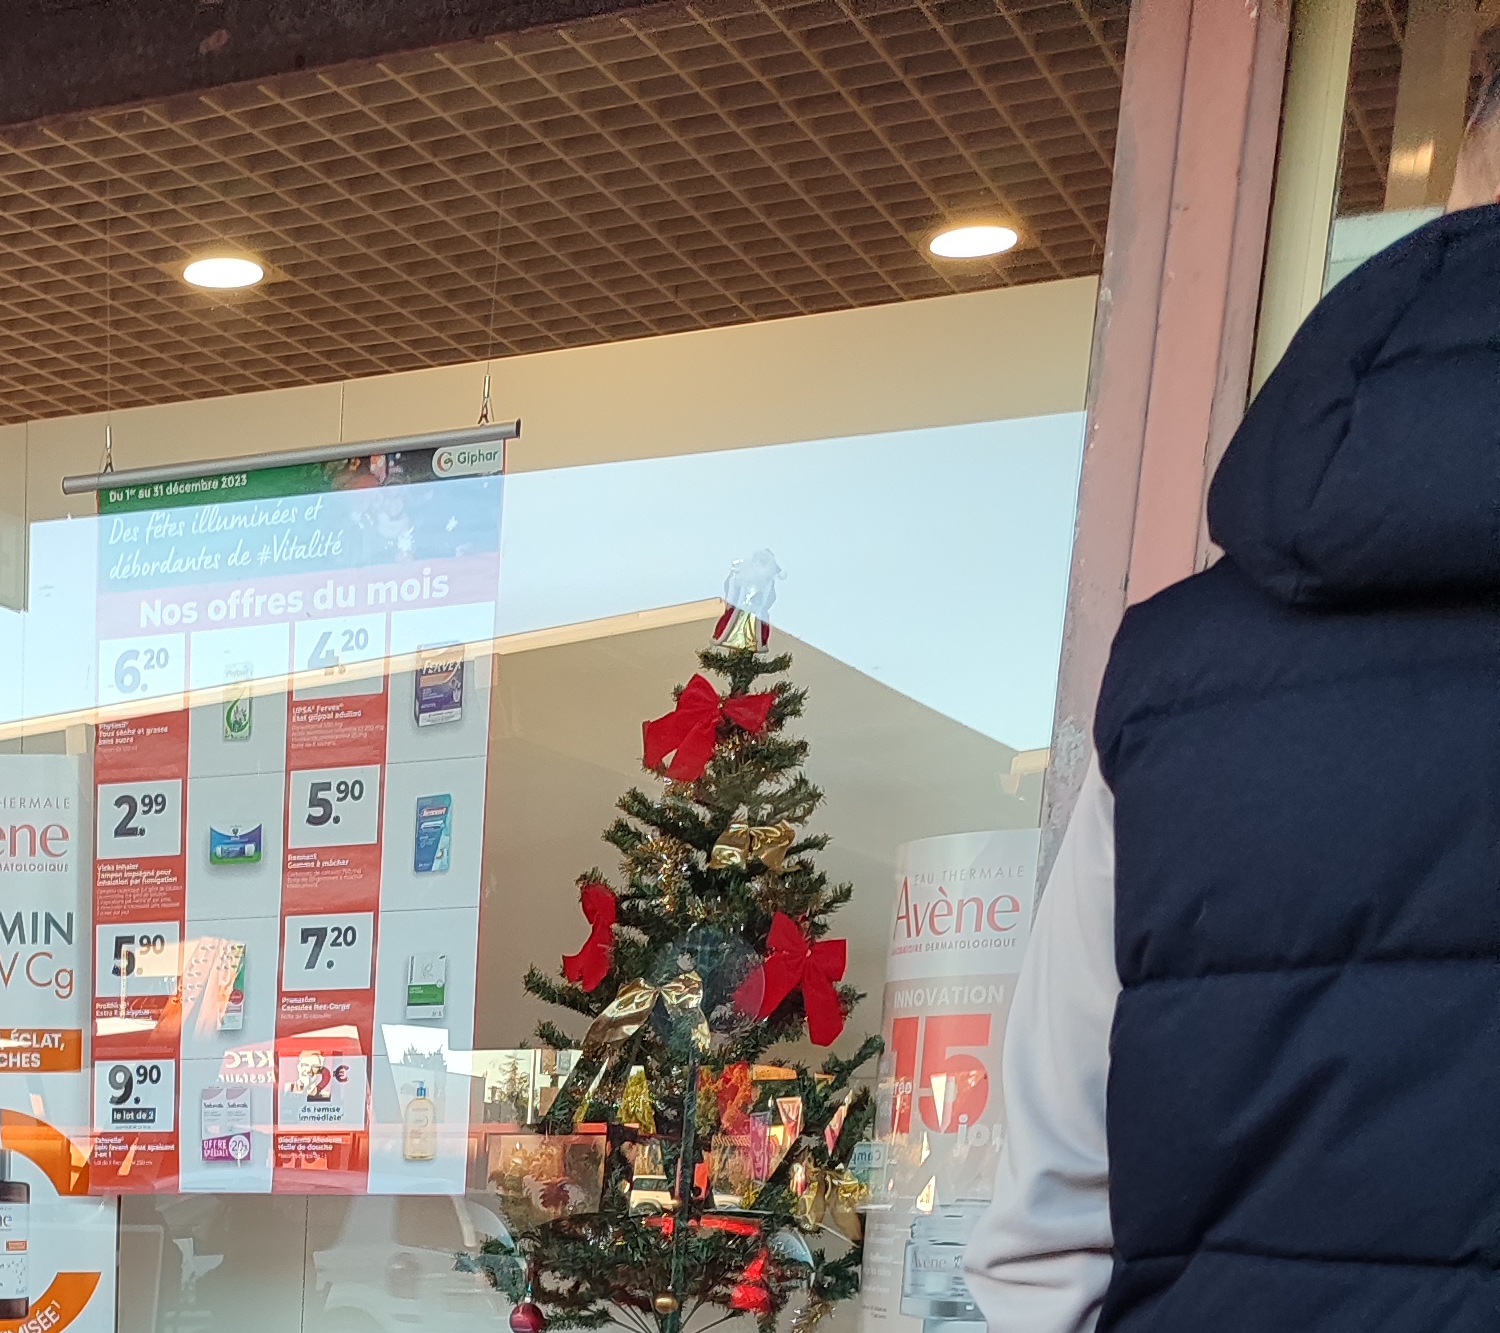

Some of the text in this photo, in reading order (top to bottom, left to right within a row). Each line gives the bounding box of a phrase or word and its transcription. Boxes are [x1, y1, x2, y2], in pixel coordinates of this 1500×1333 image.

[456, 448, 499, 467] Giphar
[109, 490, 124, 503] Du
[138, 488, 151, 500] au
[153, 484, 163, 497] 31
[165, 478, 219, 496] décembre
[220, 473, 247, 489] 2023
[108, 495, 324, 545] Des fêtes illuminées et
[109, 528, 344, 580] débordantes de #Vitalité
[139, 567, 449, 629] Nos offres du mois
[422, 657, 463, 675] FERVEX
[913, 865, 1026, 886] EAU THERMALE
[893, 876, 1020, 941] Avène
[925, 937, 1017, 952] DERMATOLOGIQUE
[25, 951, 74, 1000] Cg
[893, 985, 1005, 1009] INNOVATION
[891, 1013, 992, 1135] 15
[113, 1110, 147, 1120] le lot de
[301, 1105, 341, 1113] de remise
